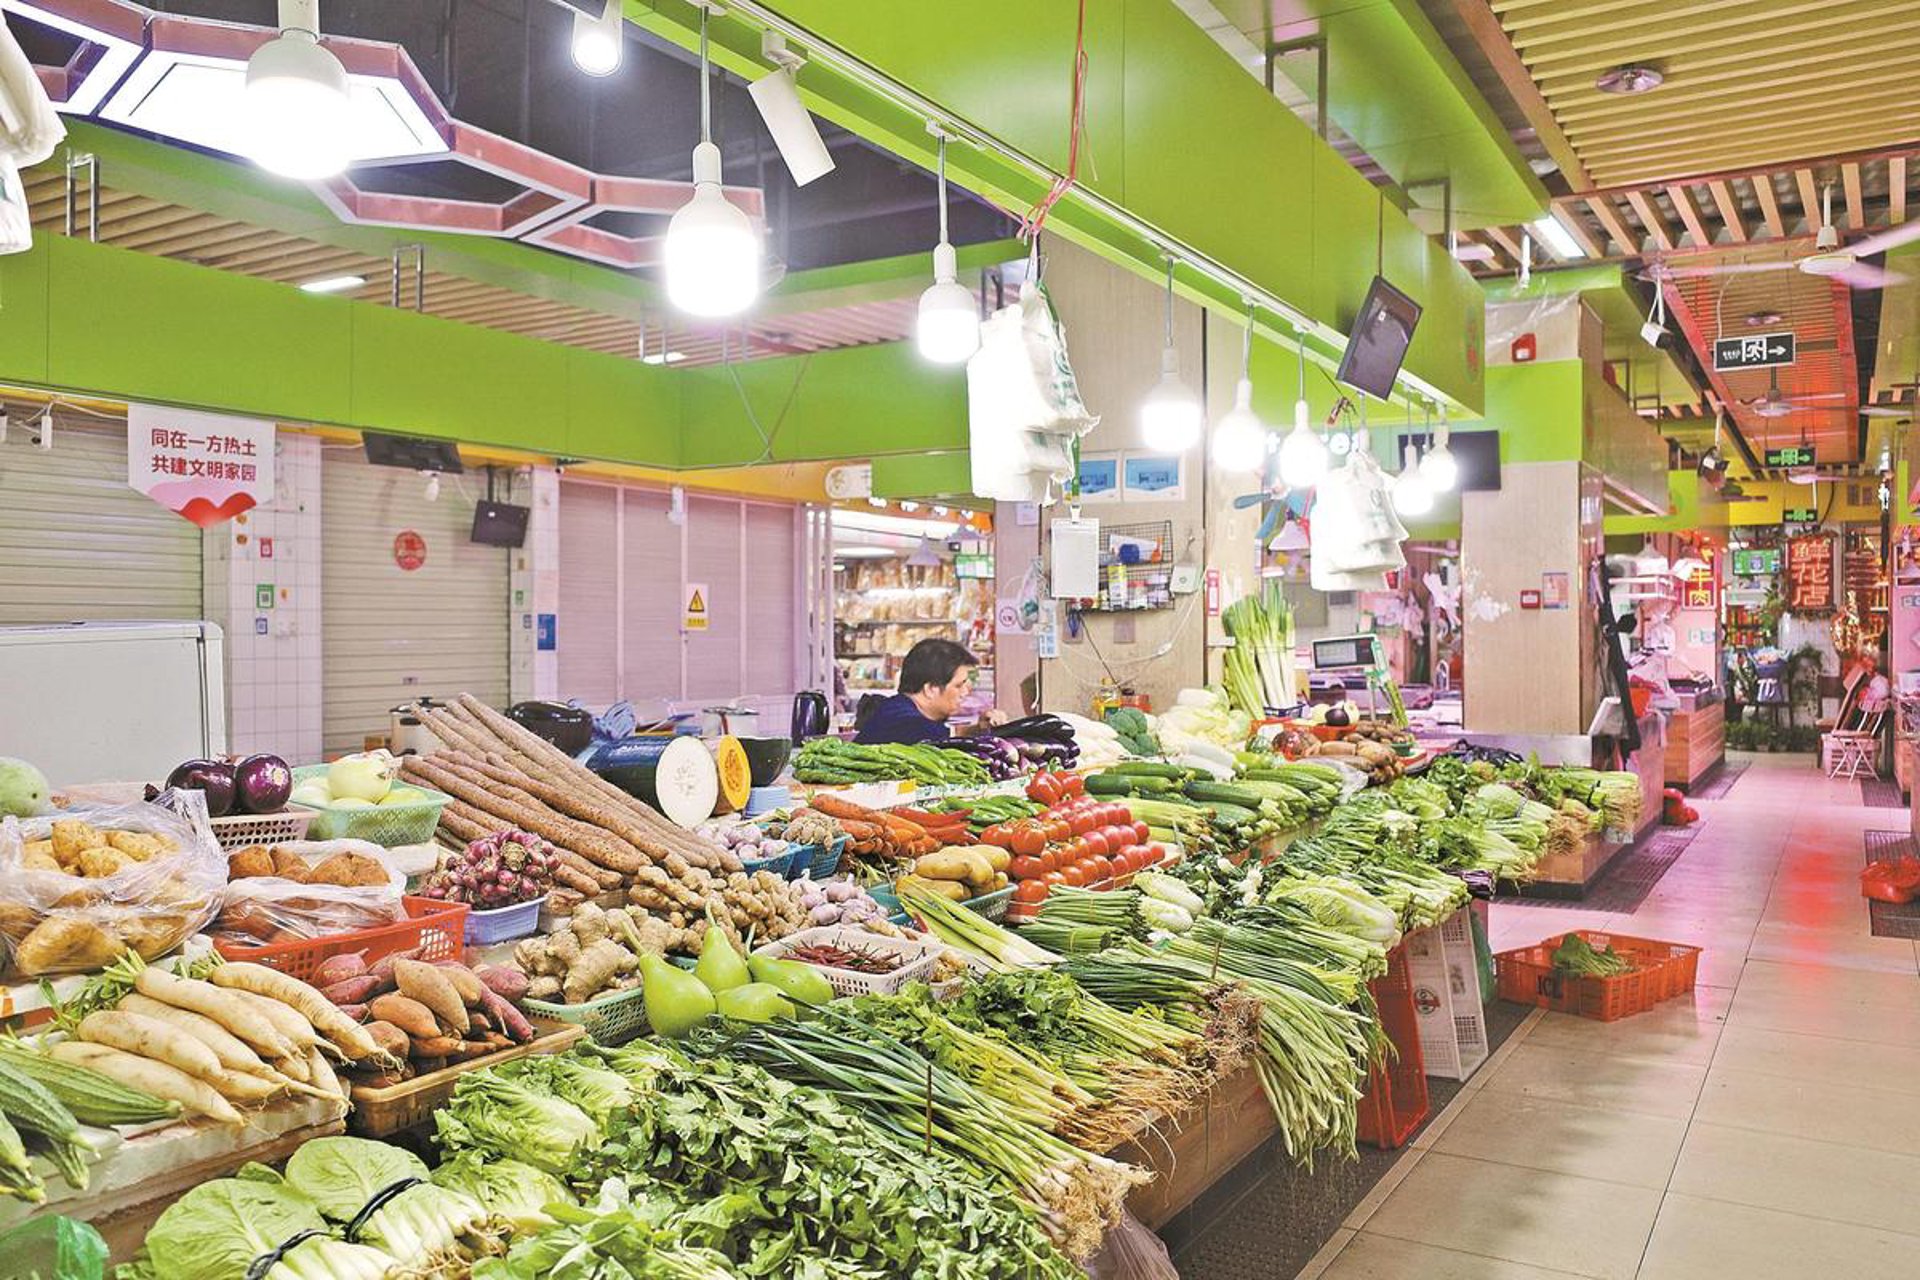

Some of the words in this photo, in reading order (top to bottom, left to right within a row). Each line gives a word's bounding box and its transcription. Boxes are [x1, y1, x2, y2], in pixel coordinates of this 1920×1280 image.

[152, 428, 257, 457] 同在一方热土
[152, 454, 257, 481] 共建文明家园
[1791, 540, 1831, 606] 鲜花店
